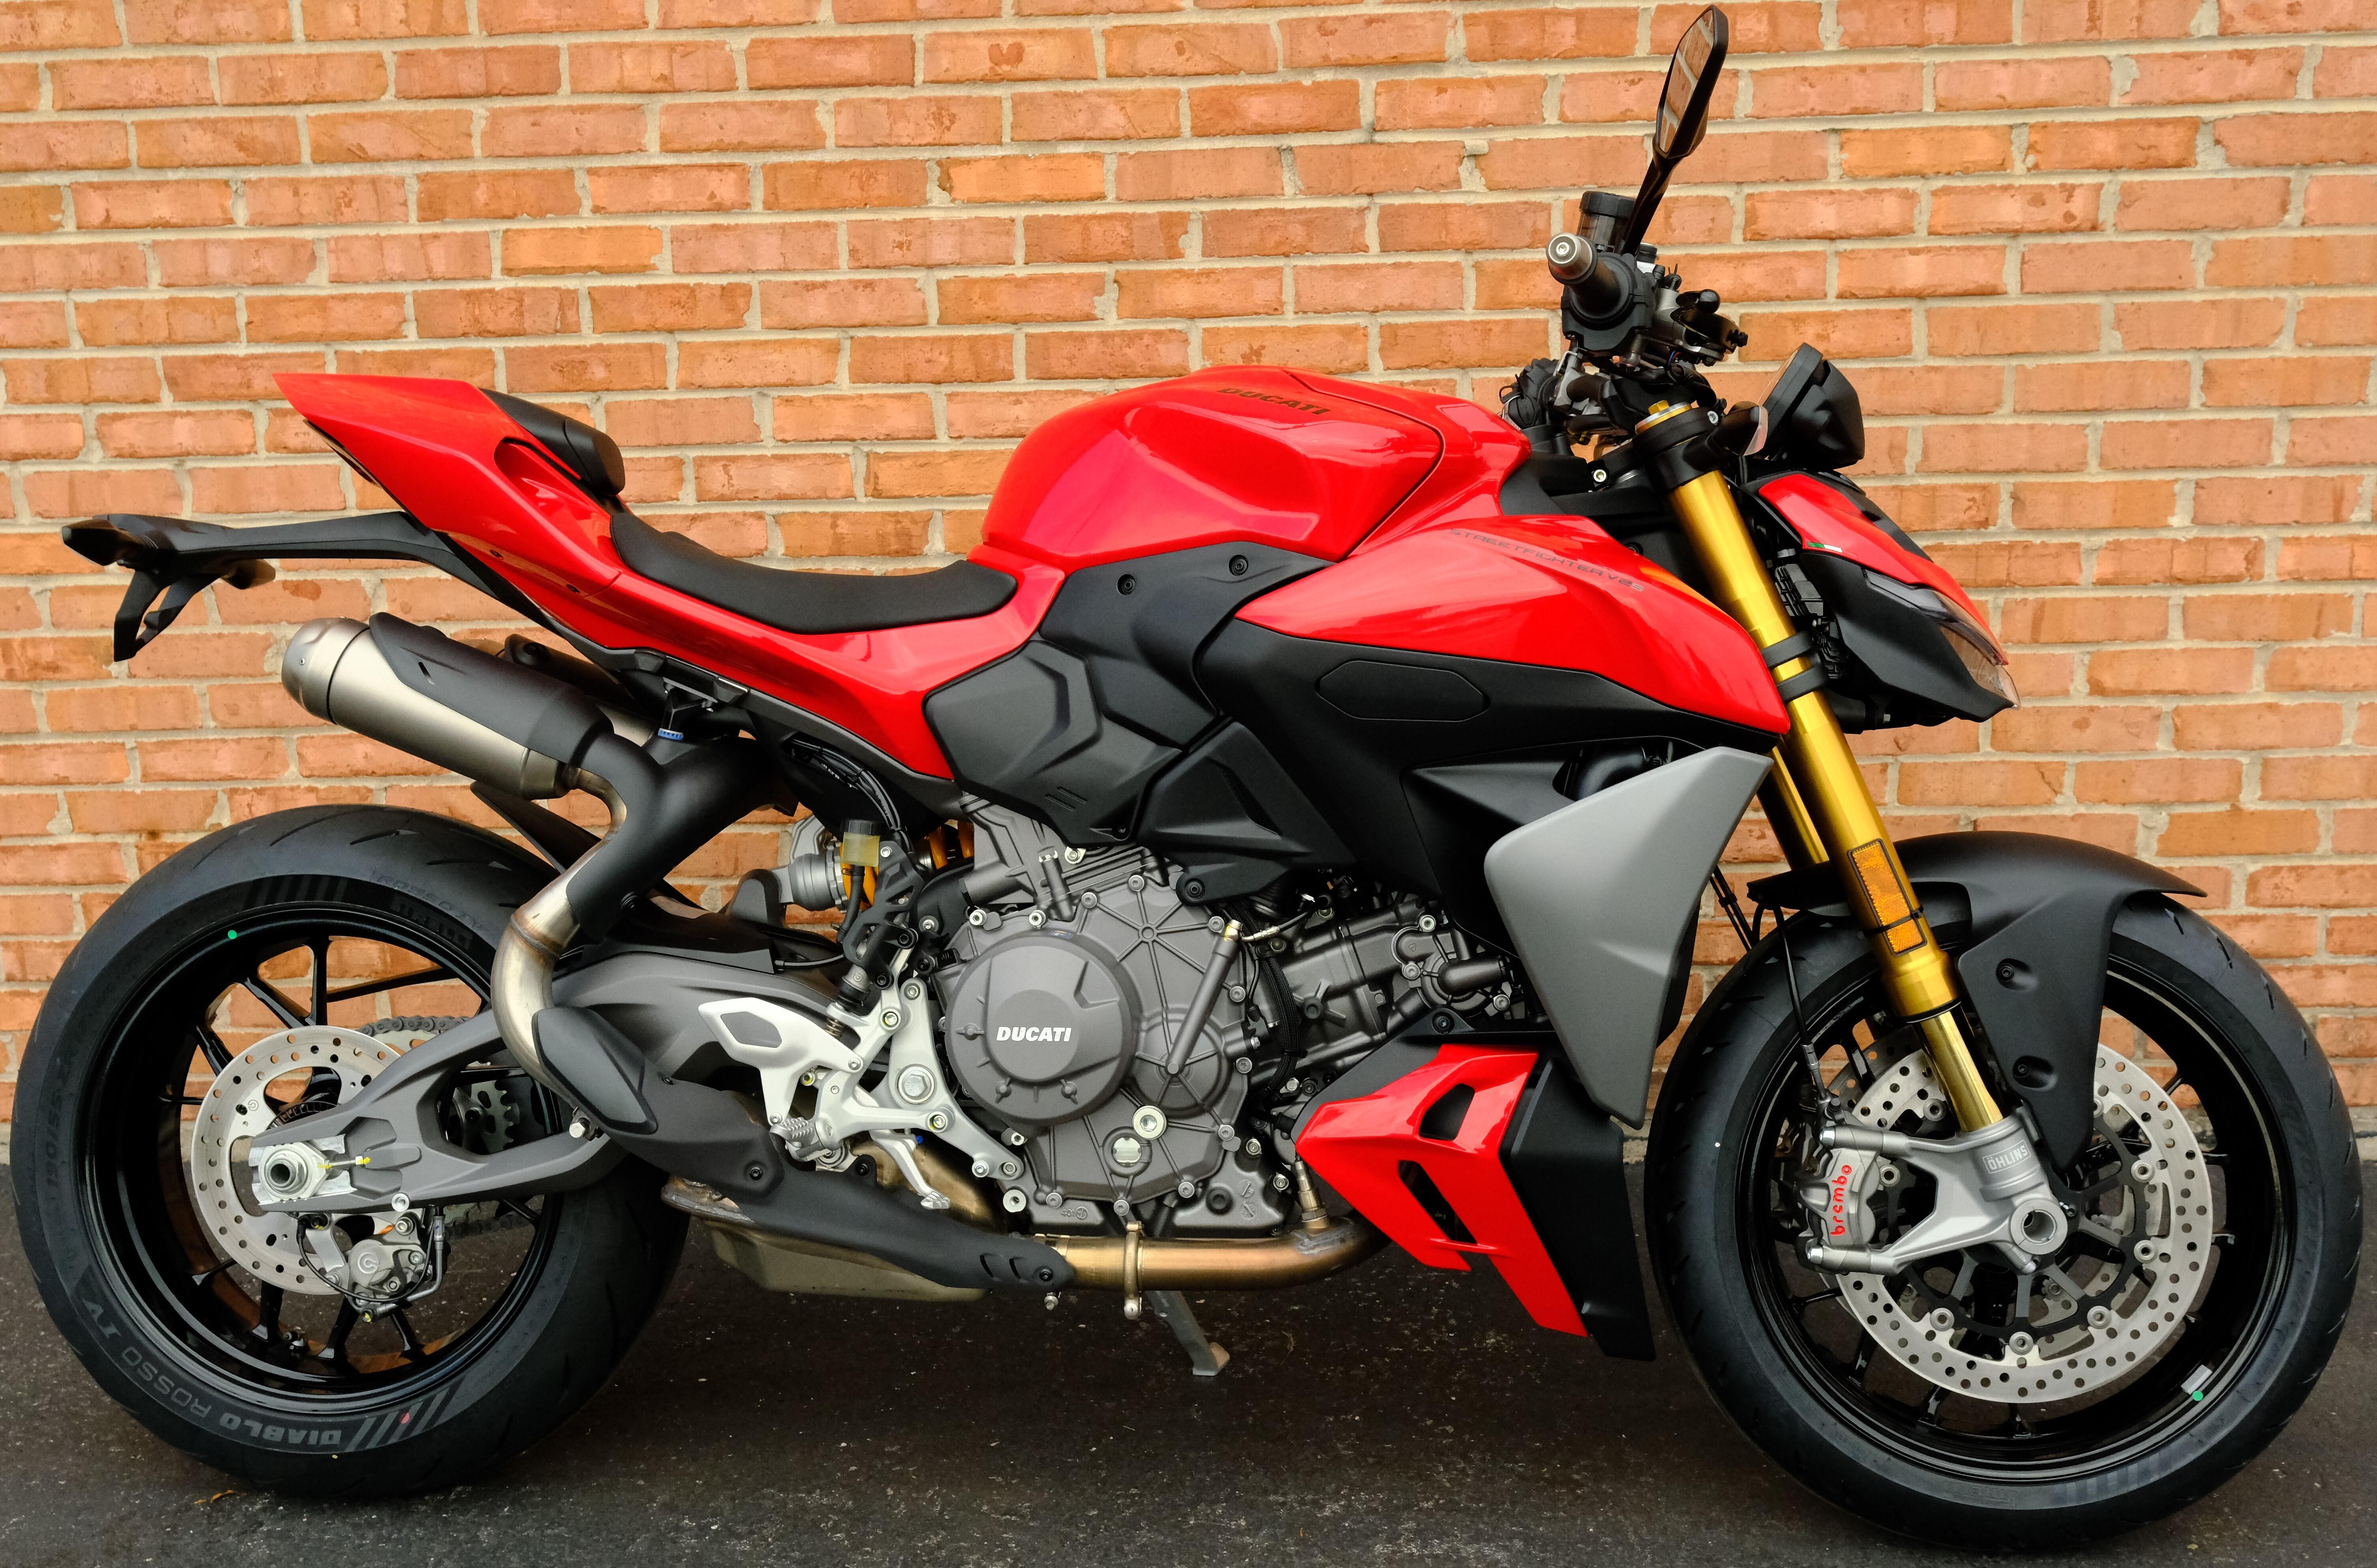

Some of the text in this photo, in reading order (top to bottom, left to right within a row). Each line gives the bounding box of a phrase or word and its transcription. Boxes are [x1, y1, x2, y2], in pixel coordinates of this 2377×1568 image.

[1217, 388, 1330, 415] DUCATI
[1450, 528, 1604, 576] STREETFIGHTER
[996, 1027, 1071, 1041] DUCATI
[1986, 1145, 2027, 1170] ÖHLINS
[1830, 1165, 1852, 1236] brembo
[83, 1299, 342, 1447] DIABLO ROSSO IV
